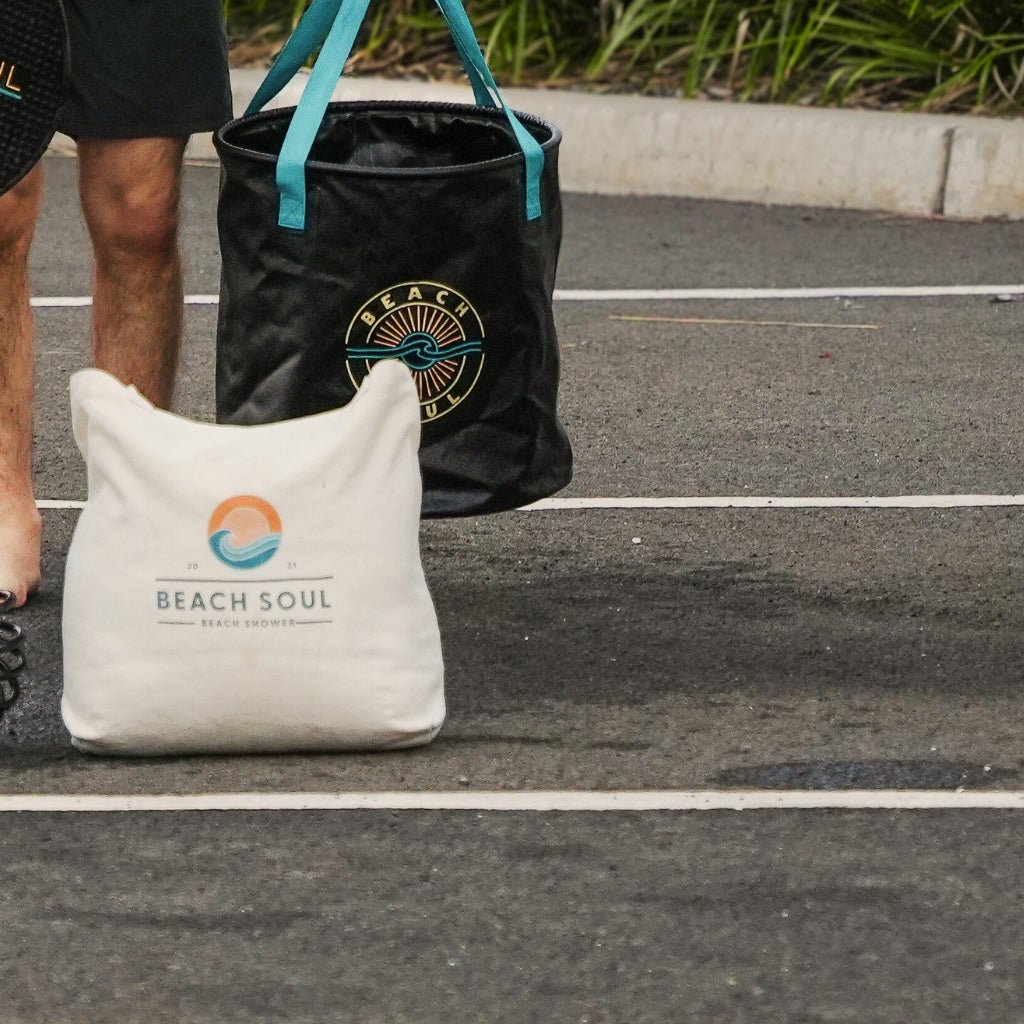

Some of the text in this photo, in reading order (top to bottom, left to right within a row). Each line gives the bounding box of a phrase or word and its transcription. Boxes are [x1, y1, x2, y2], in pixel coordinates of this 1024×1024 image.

[360, 287, 469, 326] BEACH
[156, 590, 332, 611] BEACH SOUL
[201, 619, 295, 628] BEACH SHOWER
